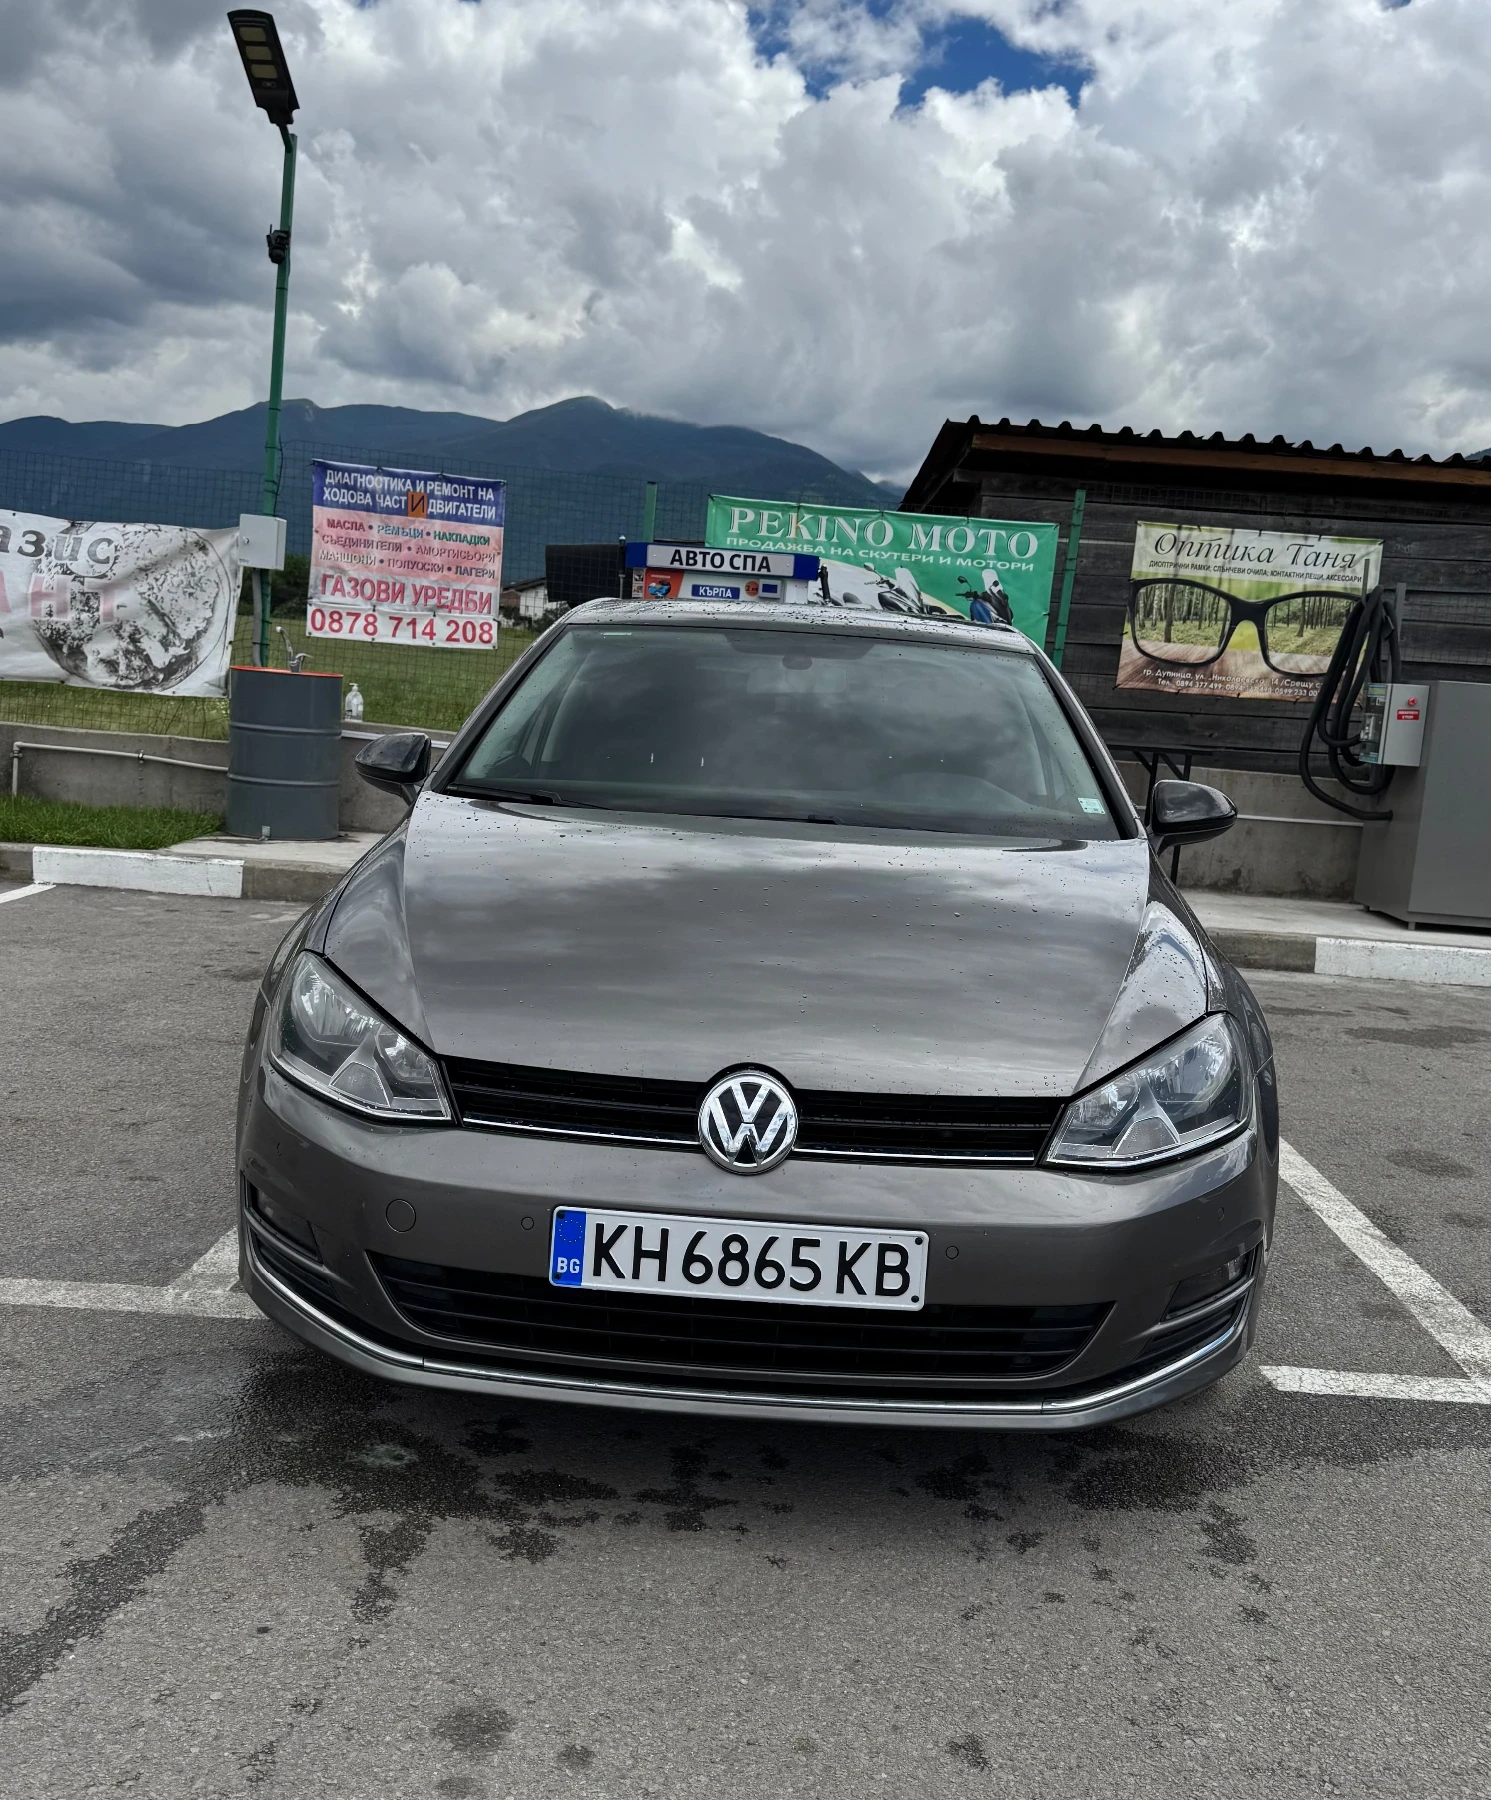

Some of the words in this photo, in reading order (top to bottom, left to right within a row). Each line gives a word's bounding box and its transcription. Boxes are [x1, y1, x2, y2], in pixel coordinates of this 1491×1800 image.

[326, 470, 412, 492] ДИАГНОСТИКА
[416, 481, 424, 493] И
[427, 481, 475, 497] РЕМОНТ
[478, 487, 494, 501] НА
[323, 487, 372, 506] ХОДОВА
[376, 494, 407, 509] ЧАСТ
[428, 499, 496, 519] ДВИГАТЕЛИ
[326, 518, 366, 532] МАСЛА
[377, 525, 423, 539] РЕМЪЦИ
[433, 530, 490, 546] НАКЛАДКИ
[728, 507, 894, 547] PEKINO
[907, 524, 1038, 559] MOTO
[322, 534, 402, 552] СЪЕДИНИТЕЛИ
[416, 545, 496, 563] АМОРТИСЬОРИ
[670, 549, 725, 570] АВТО
[729, 555, 771, 573] СПА
[726, 537, 825, 554] ПРОДАЖБА
[830, 547, 854, 557] НА
[859, 549, 934, 563] СКУТЕРИ
[939, 557, 951, 565] И
[956, 558, 1034, 571] МОТОРИ
[1154, 532, 1276, 563] Оптика
[1286, 543, 1357, 569] Таня
[320, 550, 376, 566] МАНШОНИ
[387, 558, 444, 573] ПОЛУОСКИ
[454, 565, 495, 579] ЛАГЕРИ
[1149, 560, 1190, 570] ДИОПТРИЧНИ
[1213, 565, 1246, 575] СЛЪНЧЕВИ
[1270, 571, 1304, 579] КОНТАКТНИ
[1325, 574, 1362, 582] АКСЕСОАРИ
[321, 573, 405, 605] ГАЗОВИ
[411, 583, 492, 615] УРЕДБИ
[699, 586, 732, 598] КЪРПА
[310, 608, 378, 637] 0878
[388, 616, 436, 641] 714
[445, 619, 493, 644] 208
[1143, 669, 1154, 677] гр.
[1175, 679, 1193, 688] 0894
[1195, 681, 1208, 689] 377
[557, 1257, 580, 1274] BG
[592, 1222, 670, 1282] KH
[682, 1230, 822, 1292] 6865
[836, 1240, 911, 1297] KB
